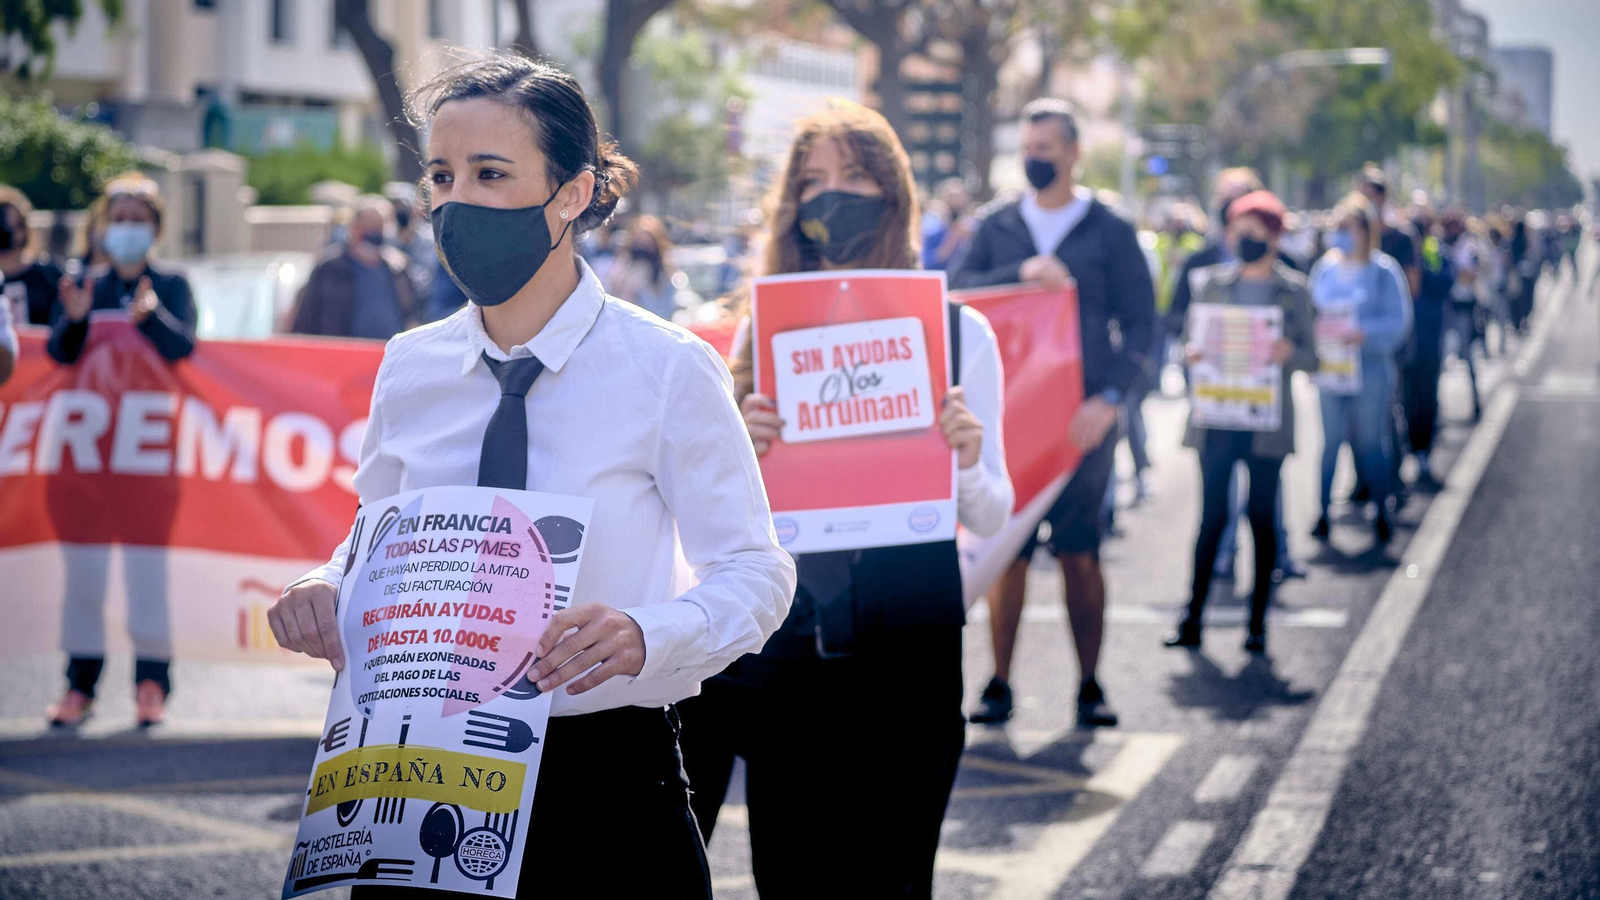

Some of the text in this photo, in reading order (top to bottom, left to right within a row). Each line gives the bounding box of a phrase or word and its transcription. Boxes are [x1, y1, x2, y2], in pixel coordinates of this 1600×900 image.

[791, 336, 913, 375] SIN AYUDAS
[819, 360, 884, 405] Nos
[798, 387, 920, 431] Arruinan!
[397, 513, 512, 535] EN FRANCIA
[385, 538, 521, 559] TODAS LAS PYMES
[368, 560, 530, 582] QUE HAYAN PERDIDO LA MITAD
[383, 579, 493, 596] DE SU FACTURACIÓN
[363, 598, 516, 628] RECIBIRÁN AYUDAS
[367, 628, 502, 653] DE HASTA 10.000€
[367, 650, 416, 671] QUEDARÁN
[416, 651, 497, 672] EXONERADAS
[374, 669, 461, 683] DEL PAGO DE LAS
[358, 687, 481, 705] COTIZACIONES SOCIALES.
[315, 757, 507, 798] EN ESPAÑA NO
[310, 826, 373, 855] HOSTELERÍA
[306, 858, 320, 875] DE
[320, 848, 362, 872] ESPAÑA
[462, 847, 502, 860] HORECA
